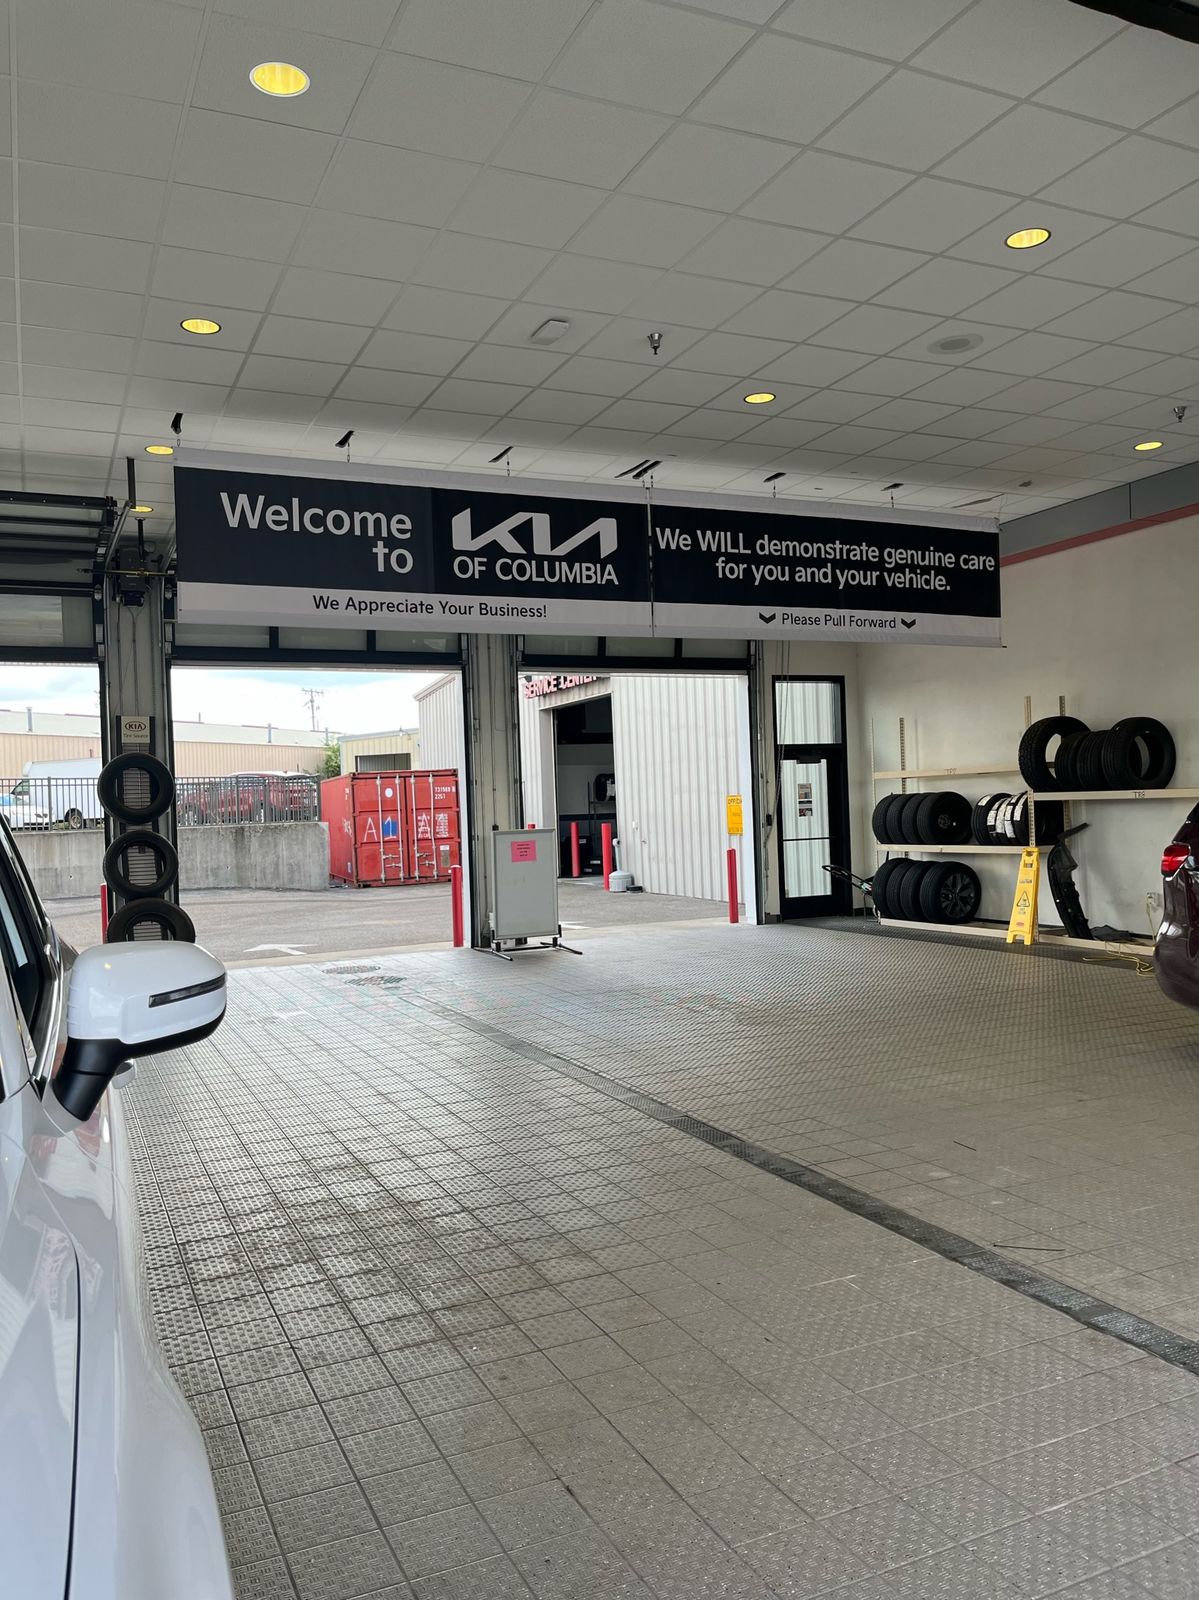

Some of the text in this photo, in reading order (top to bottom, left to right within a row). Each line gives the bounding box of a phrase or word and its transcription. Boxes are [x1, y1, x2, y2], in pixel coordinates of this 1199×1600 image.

[220, 492, 412, 540] Welcome
[451, 507, 618, 559] KIA
[372, 540, 414, 574] to
[655, 528, 995, 571] We WILL demonstrate genuine care
[453, 555, 619, 585] OF COLUMBIA
[715, 557, 951, 591] for you and your vehicle.
[312, 594, 547, 618] We Appreciate Your Business!
[781, 612, 897, 629] Please Pull Forward
[524, 675, 558, 698] SERVICE
